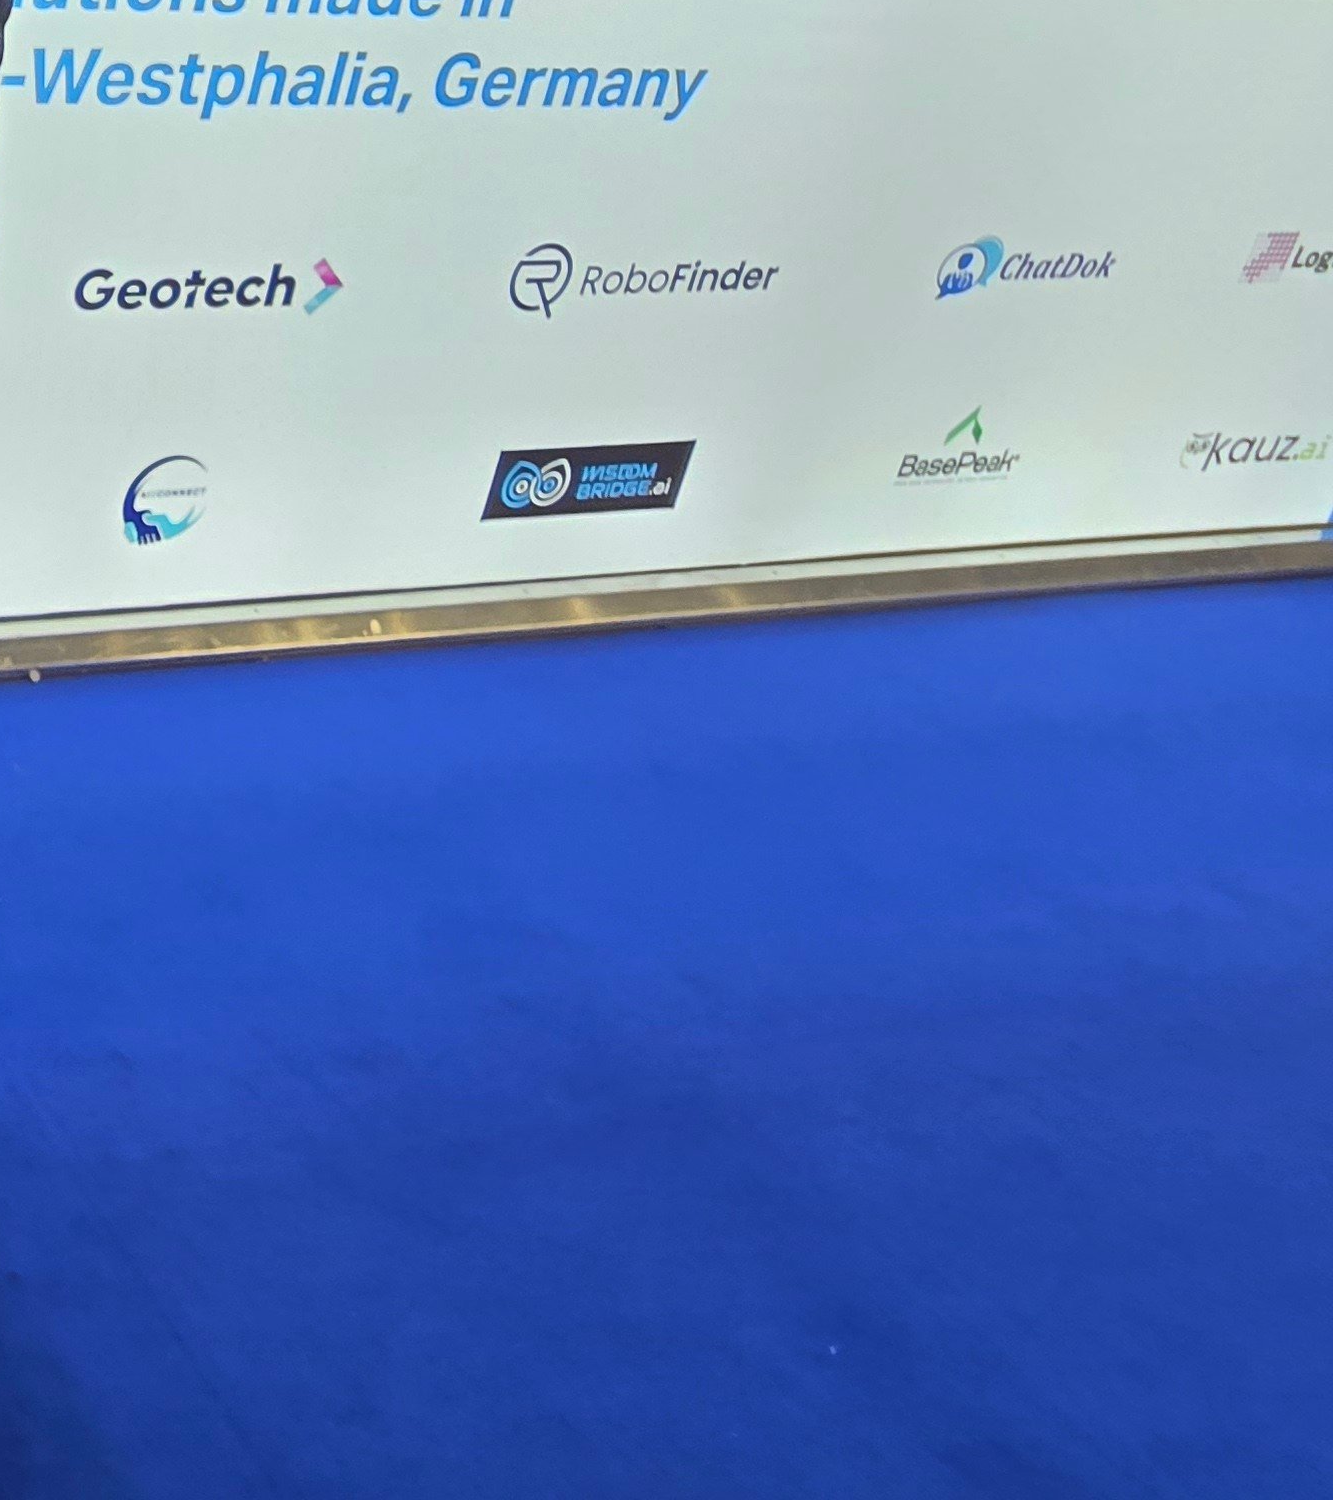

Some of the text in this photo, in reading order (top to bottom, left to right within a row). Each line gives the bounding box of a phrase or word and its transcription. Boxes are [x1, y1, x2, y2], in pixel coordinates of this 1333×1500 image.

[0, 47, 709, 122] -Westphalia, Germany
[1000, 250, 1116, 280] ChatDok
[1292, 245, 1333, 273] Log
[74, 264, 296, 312] Geotech
[580, 259, 781, 298] RoboFinder
[1201, 432, 1332, 472] kauz.ai
[576, 476, 672, 501] BRIDGE.ai
[583, 462, 658, 482] WISDOM
